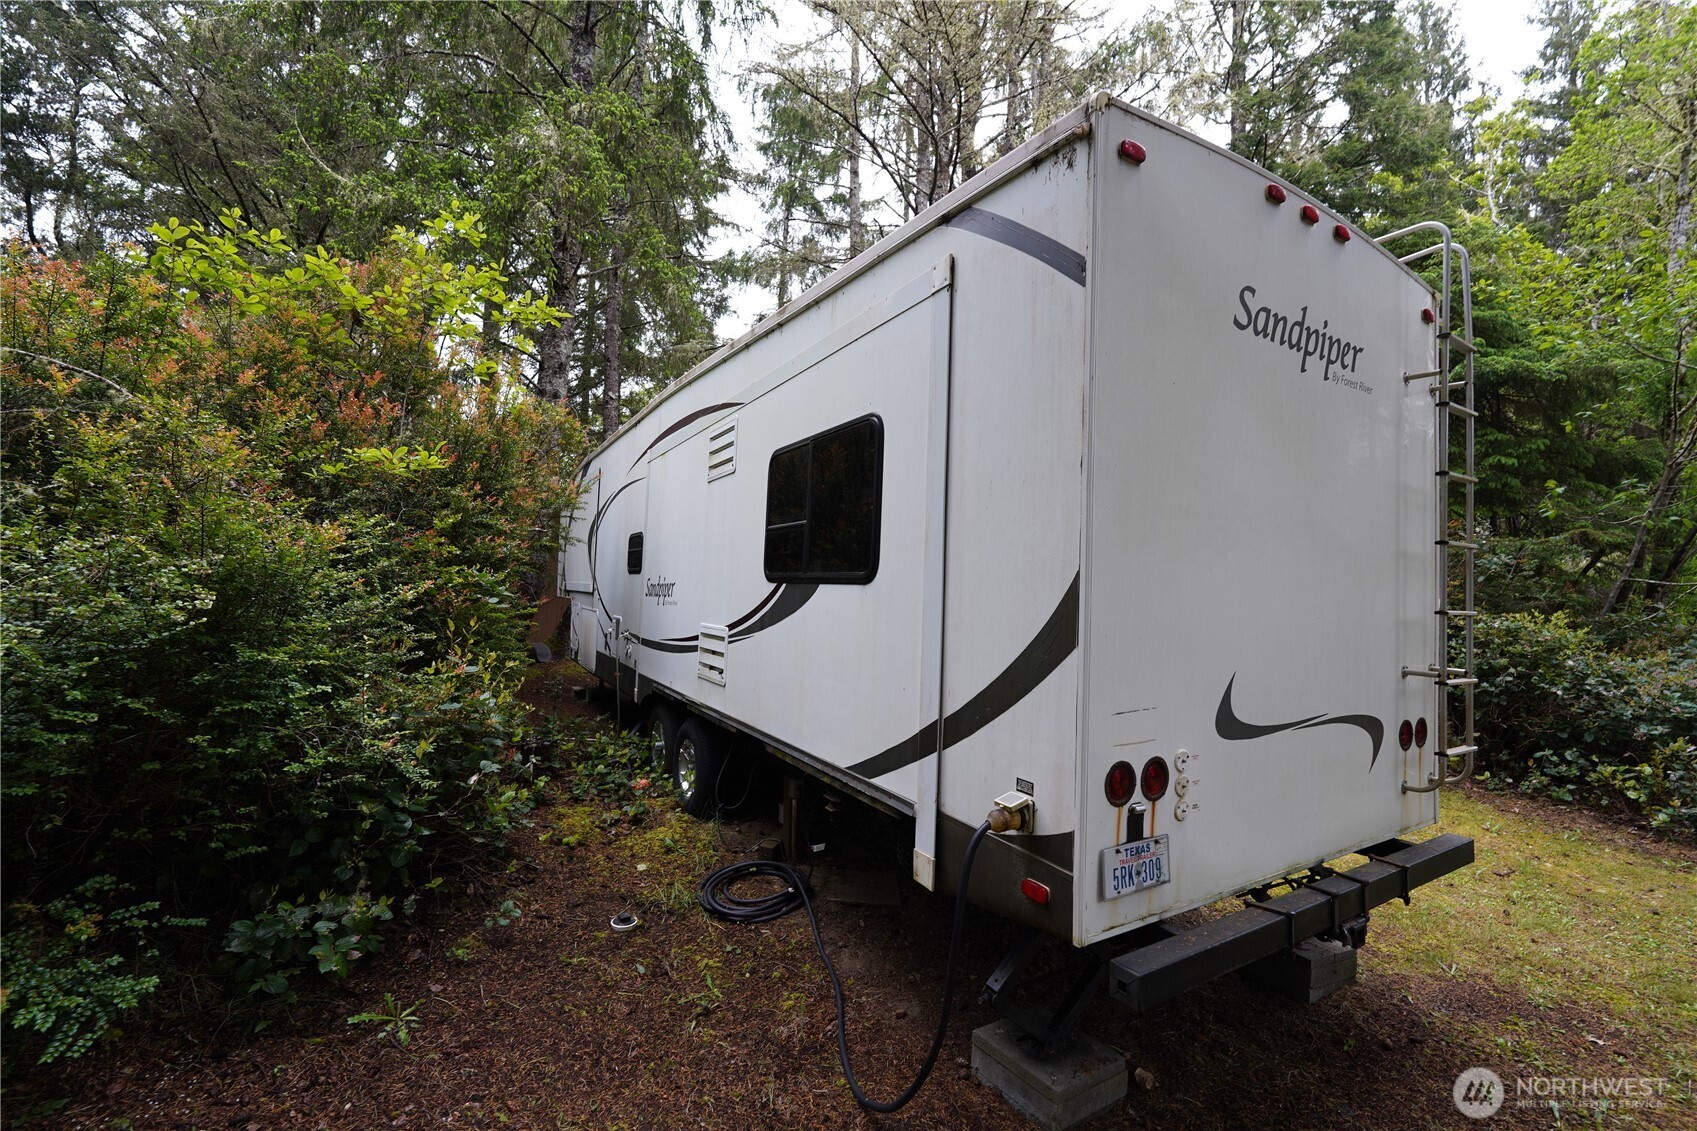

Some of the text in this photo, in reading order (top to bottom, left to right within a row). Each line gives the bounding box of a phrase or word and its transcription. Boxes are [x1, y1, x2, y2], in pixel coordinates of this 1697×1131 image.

[1233, 285, 1365, 382] Sandpiper
[1332, 371, 1374, 395] By Forest River
[1124, 843, 1151, 858] TEXAS
[1113, 857, 1162, 891] 5RK 309
